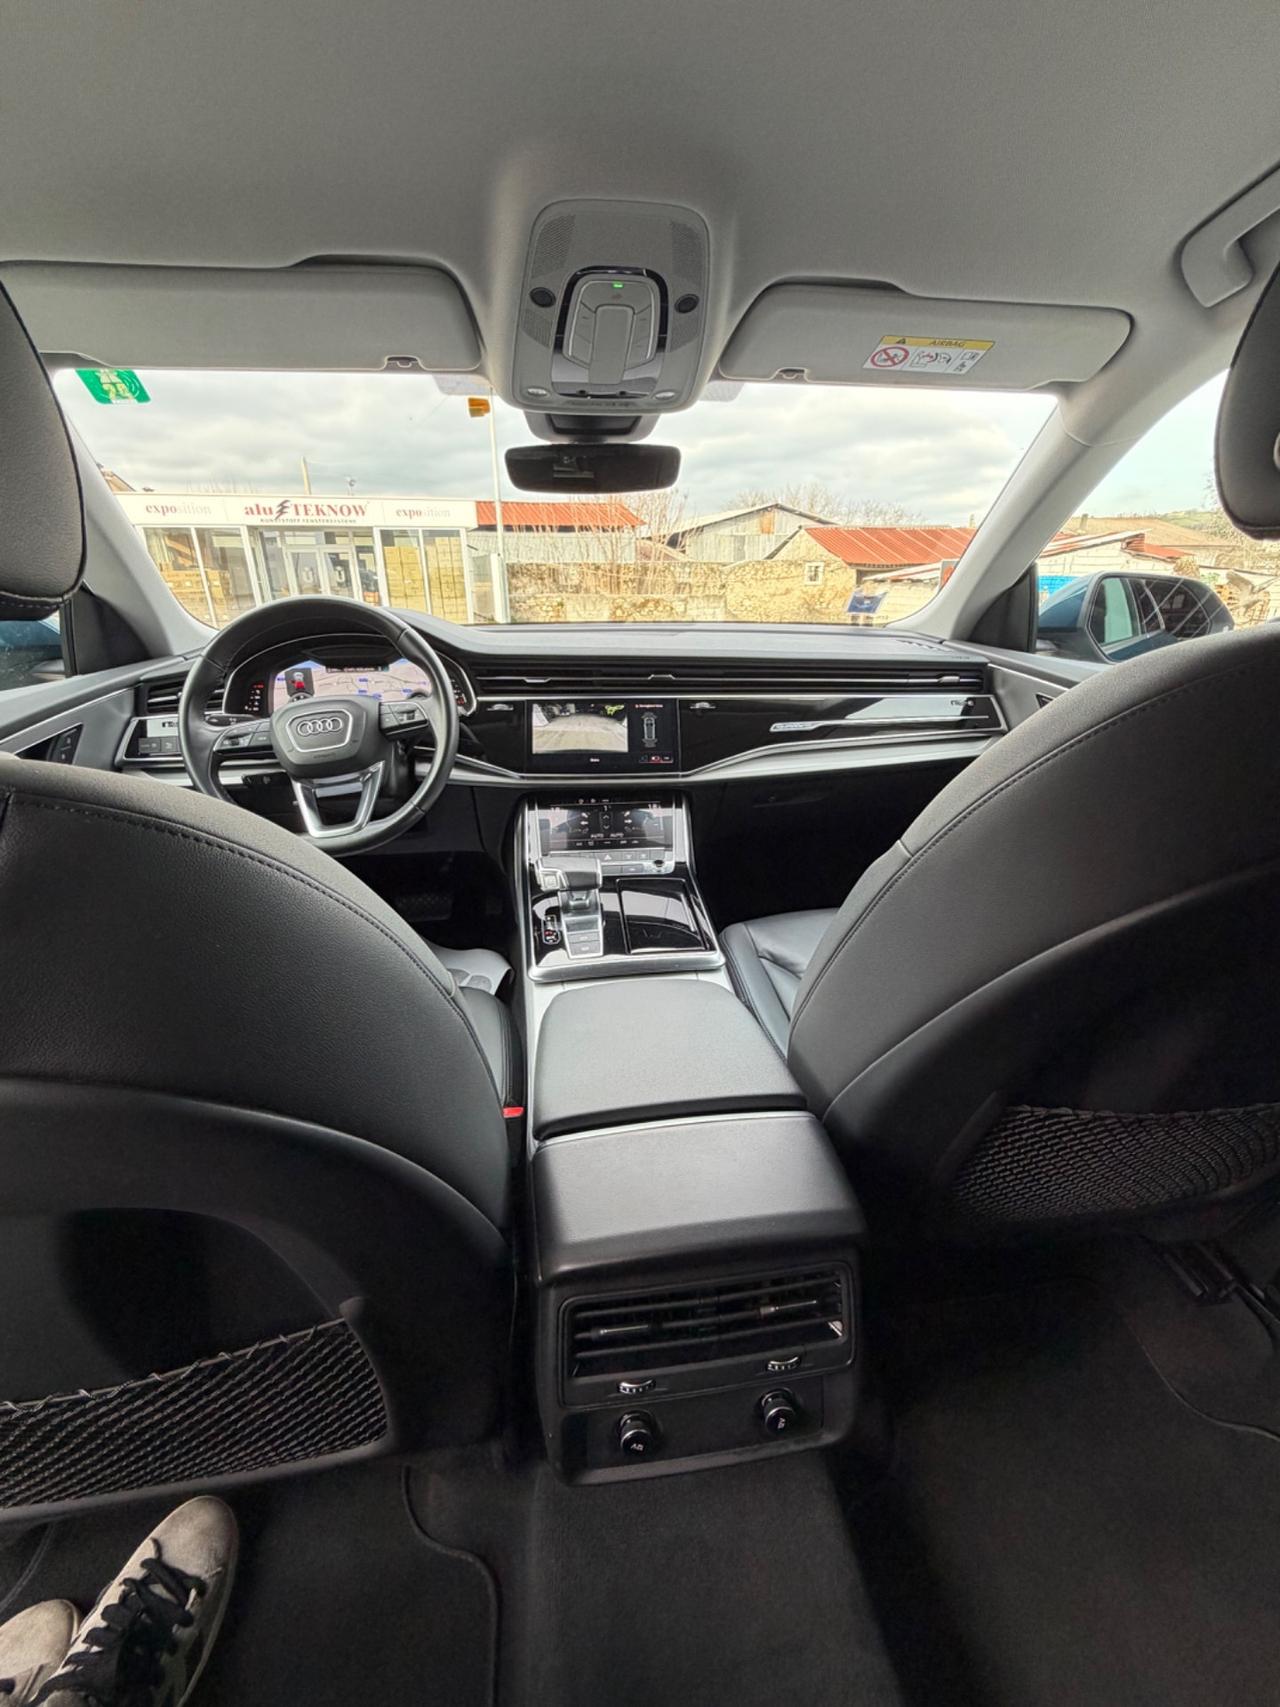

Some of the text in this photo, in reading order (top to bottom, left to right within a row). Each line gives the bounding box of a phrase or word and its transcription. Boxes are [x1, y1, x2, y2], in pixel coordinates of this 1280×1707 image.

[928, 339, 966, 348] AIRBAG
[244, 503, 367, 517] alu TEKNOW
